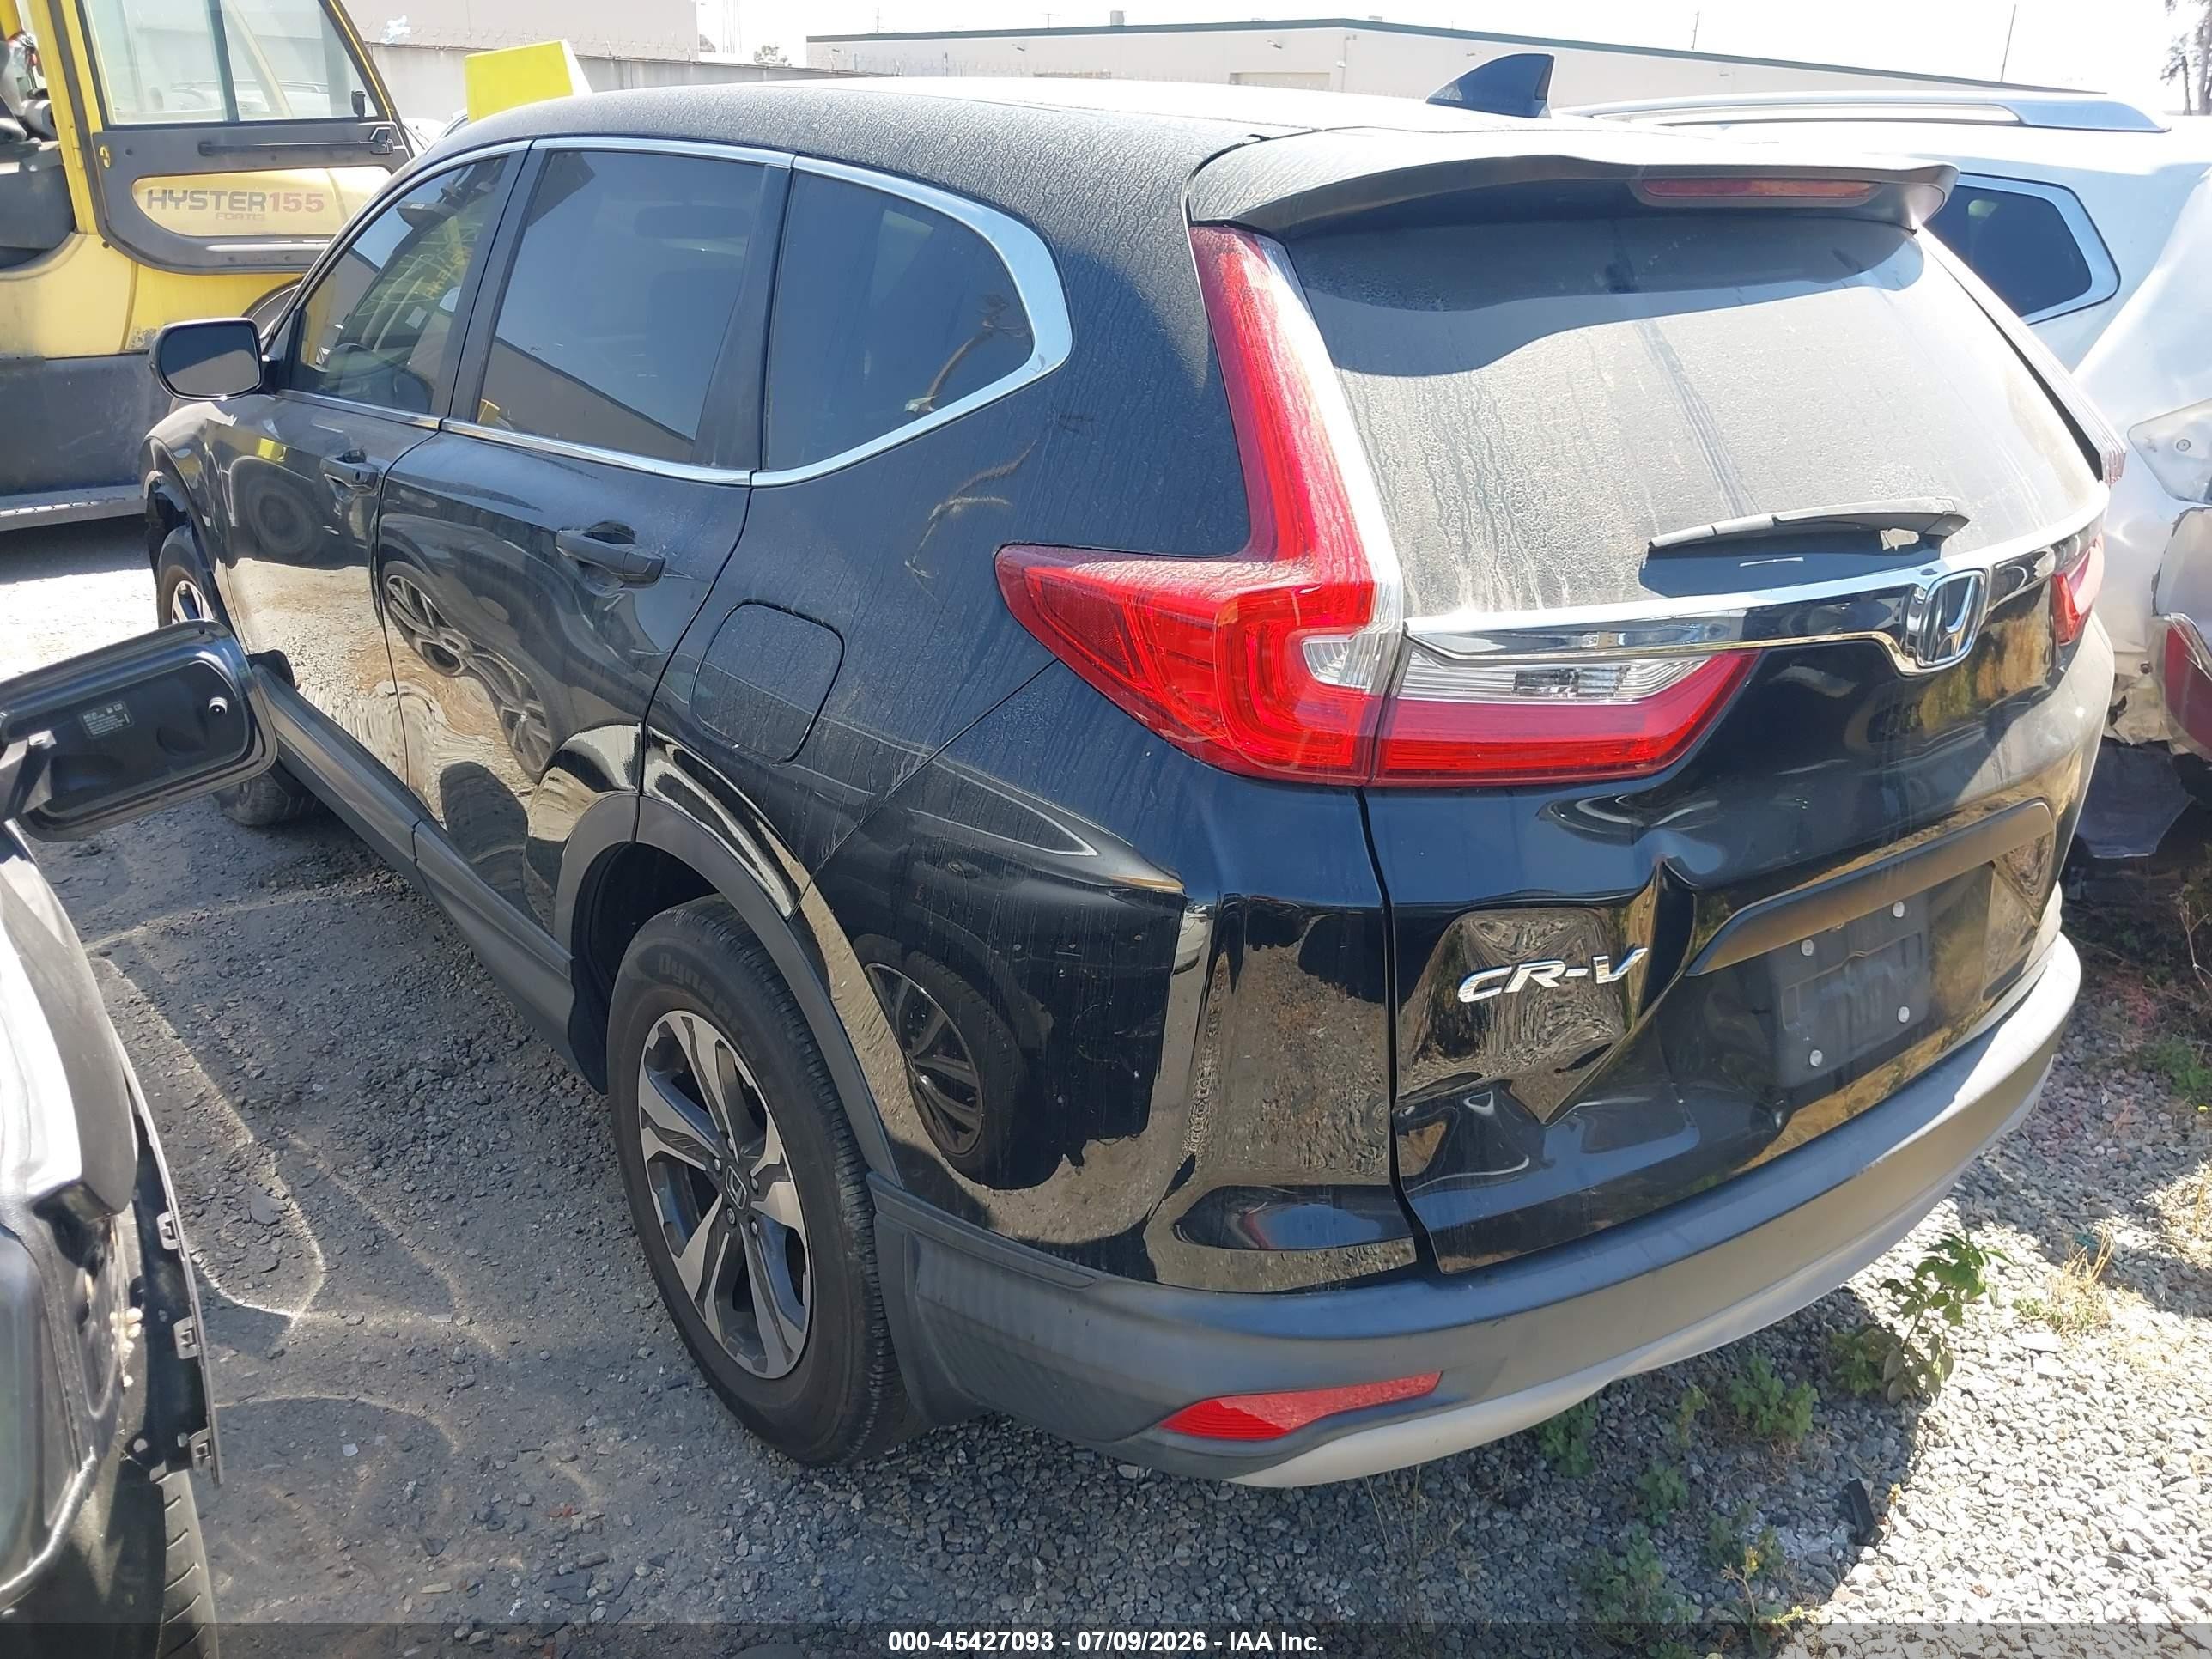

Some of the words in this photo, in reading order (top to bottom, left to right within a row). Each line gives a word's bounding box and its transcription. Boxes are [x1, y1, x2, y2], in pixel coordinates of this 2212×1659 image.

[146, 188, 268, 212] HYSTER
[269, 191, 325, 213] 155
[1458, 947, 1648, 1003] CR-V
